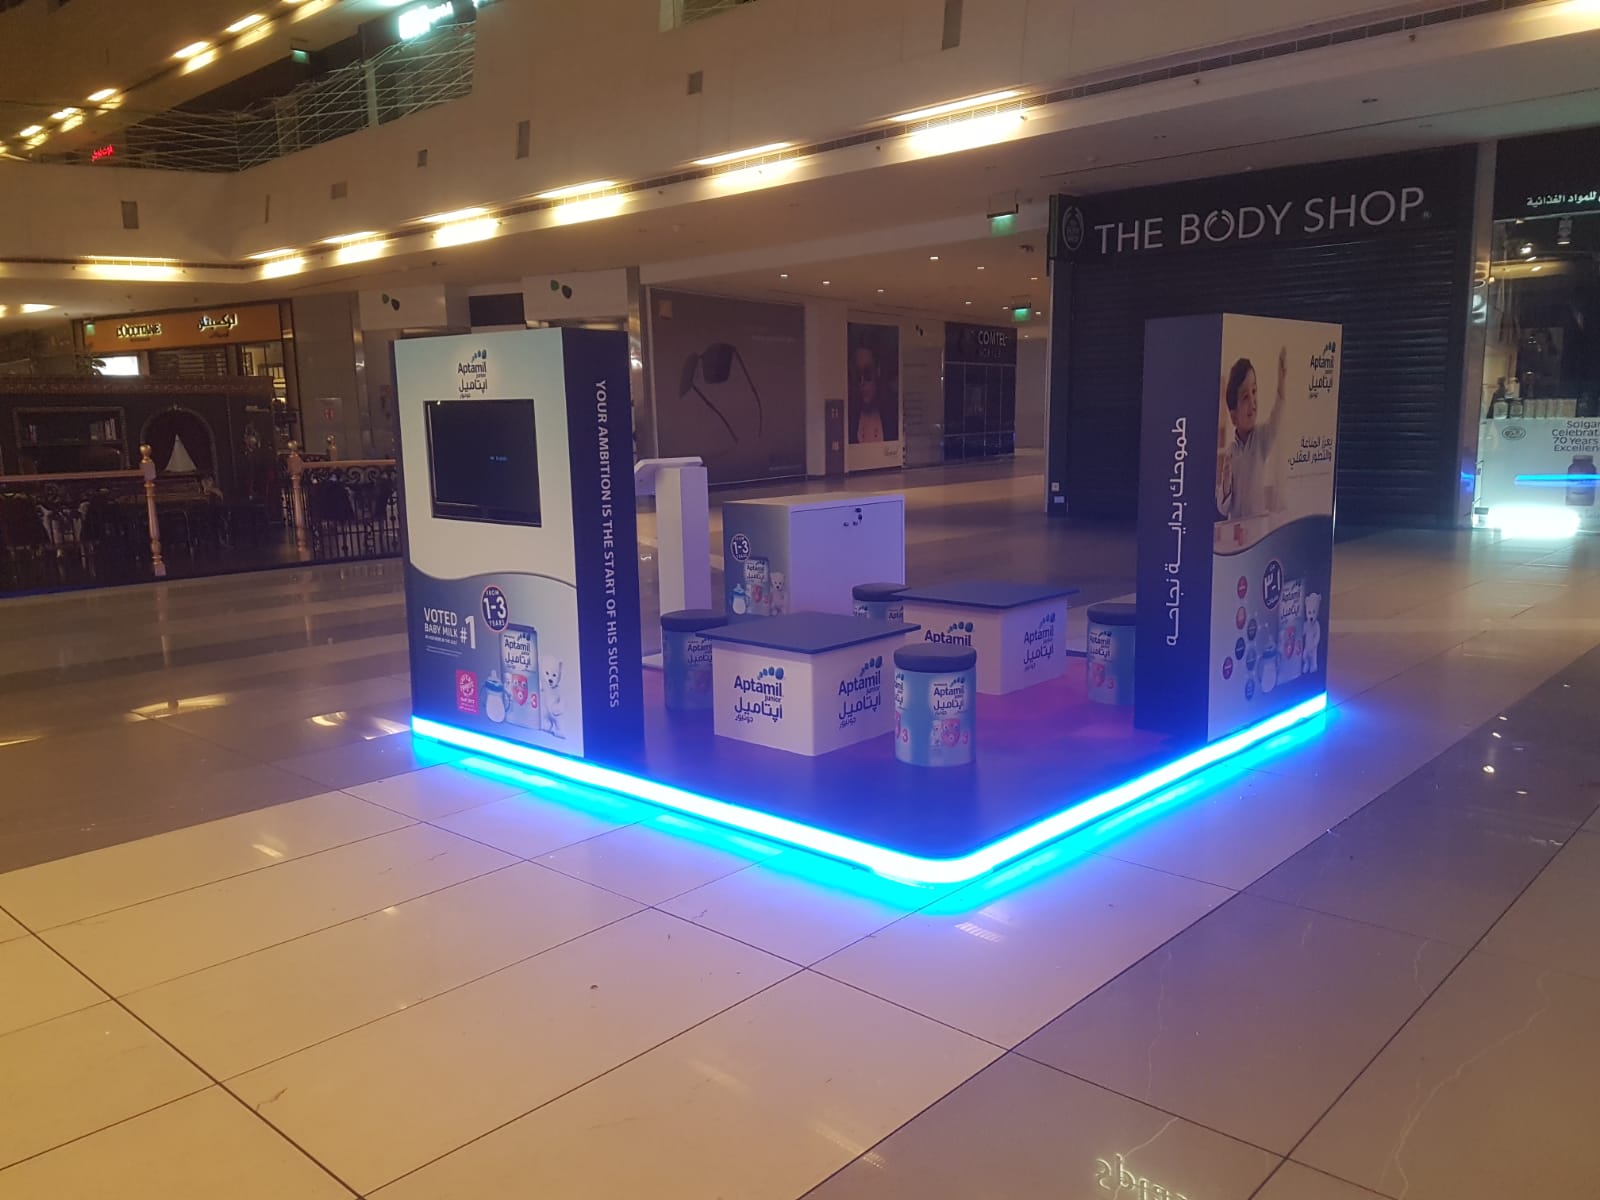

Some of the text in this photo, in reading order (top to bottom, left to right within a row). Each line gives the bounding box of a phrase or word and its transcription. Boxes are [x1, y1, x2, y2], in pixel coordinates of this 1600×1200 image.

[1568, 190, 1597, 204] للمواد
[1094, 217, 1163, 254] THE
[1180, 201, 1292, 246] BODY
[1304, 186, 1424, 233] SHOP
[457, 361, 487, 376] Aptamil
[1569, 437, 1599, 445] Years
[1169, 417, 1188, 497] طموحك
[596, 380, 620, 708] YOUR AMBITION IS THE START OF HIS SUCCESS
[733, 540, 749, 555] 1-3
[483, 596, 507, 619] 1-3
[423, 607, 458, 626] VOTED
[424, 623, 459, 638] BABY MILK
[924, 629, 971, 646] Aptamil
[1023, 624, 1053, 645] Aptamil
[504, 638, 531, 652] Aptamil
[734, 675, 782, 697] Aptamil
[838, 670, 880, 696] Aptamil
[764, 695, 781, 703] junior
[933, 685, 965, 698] Aptamil
[531, 694, 537, 708] 3
[902, 728, 909, 743] 3
